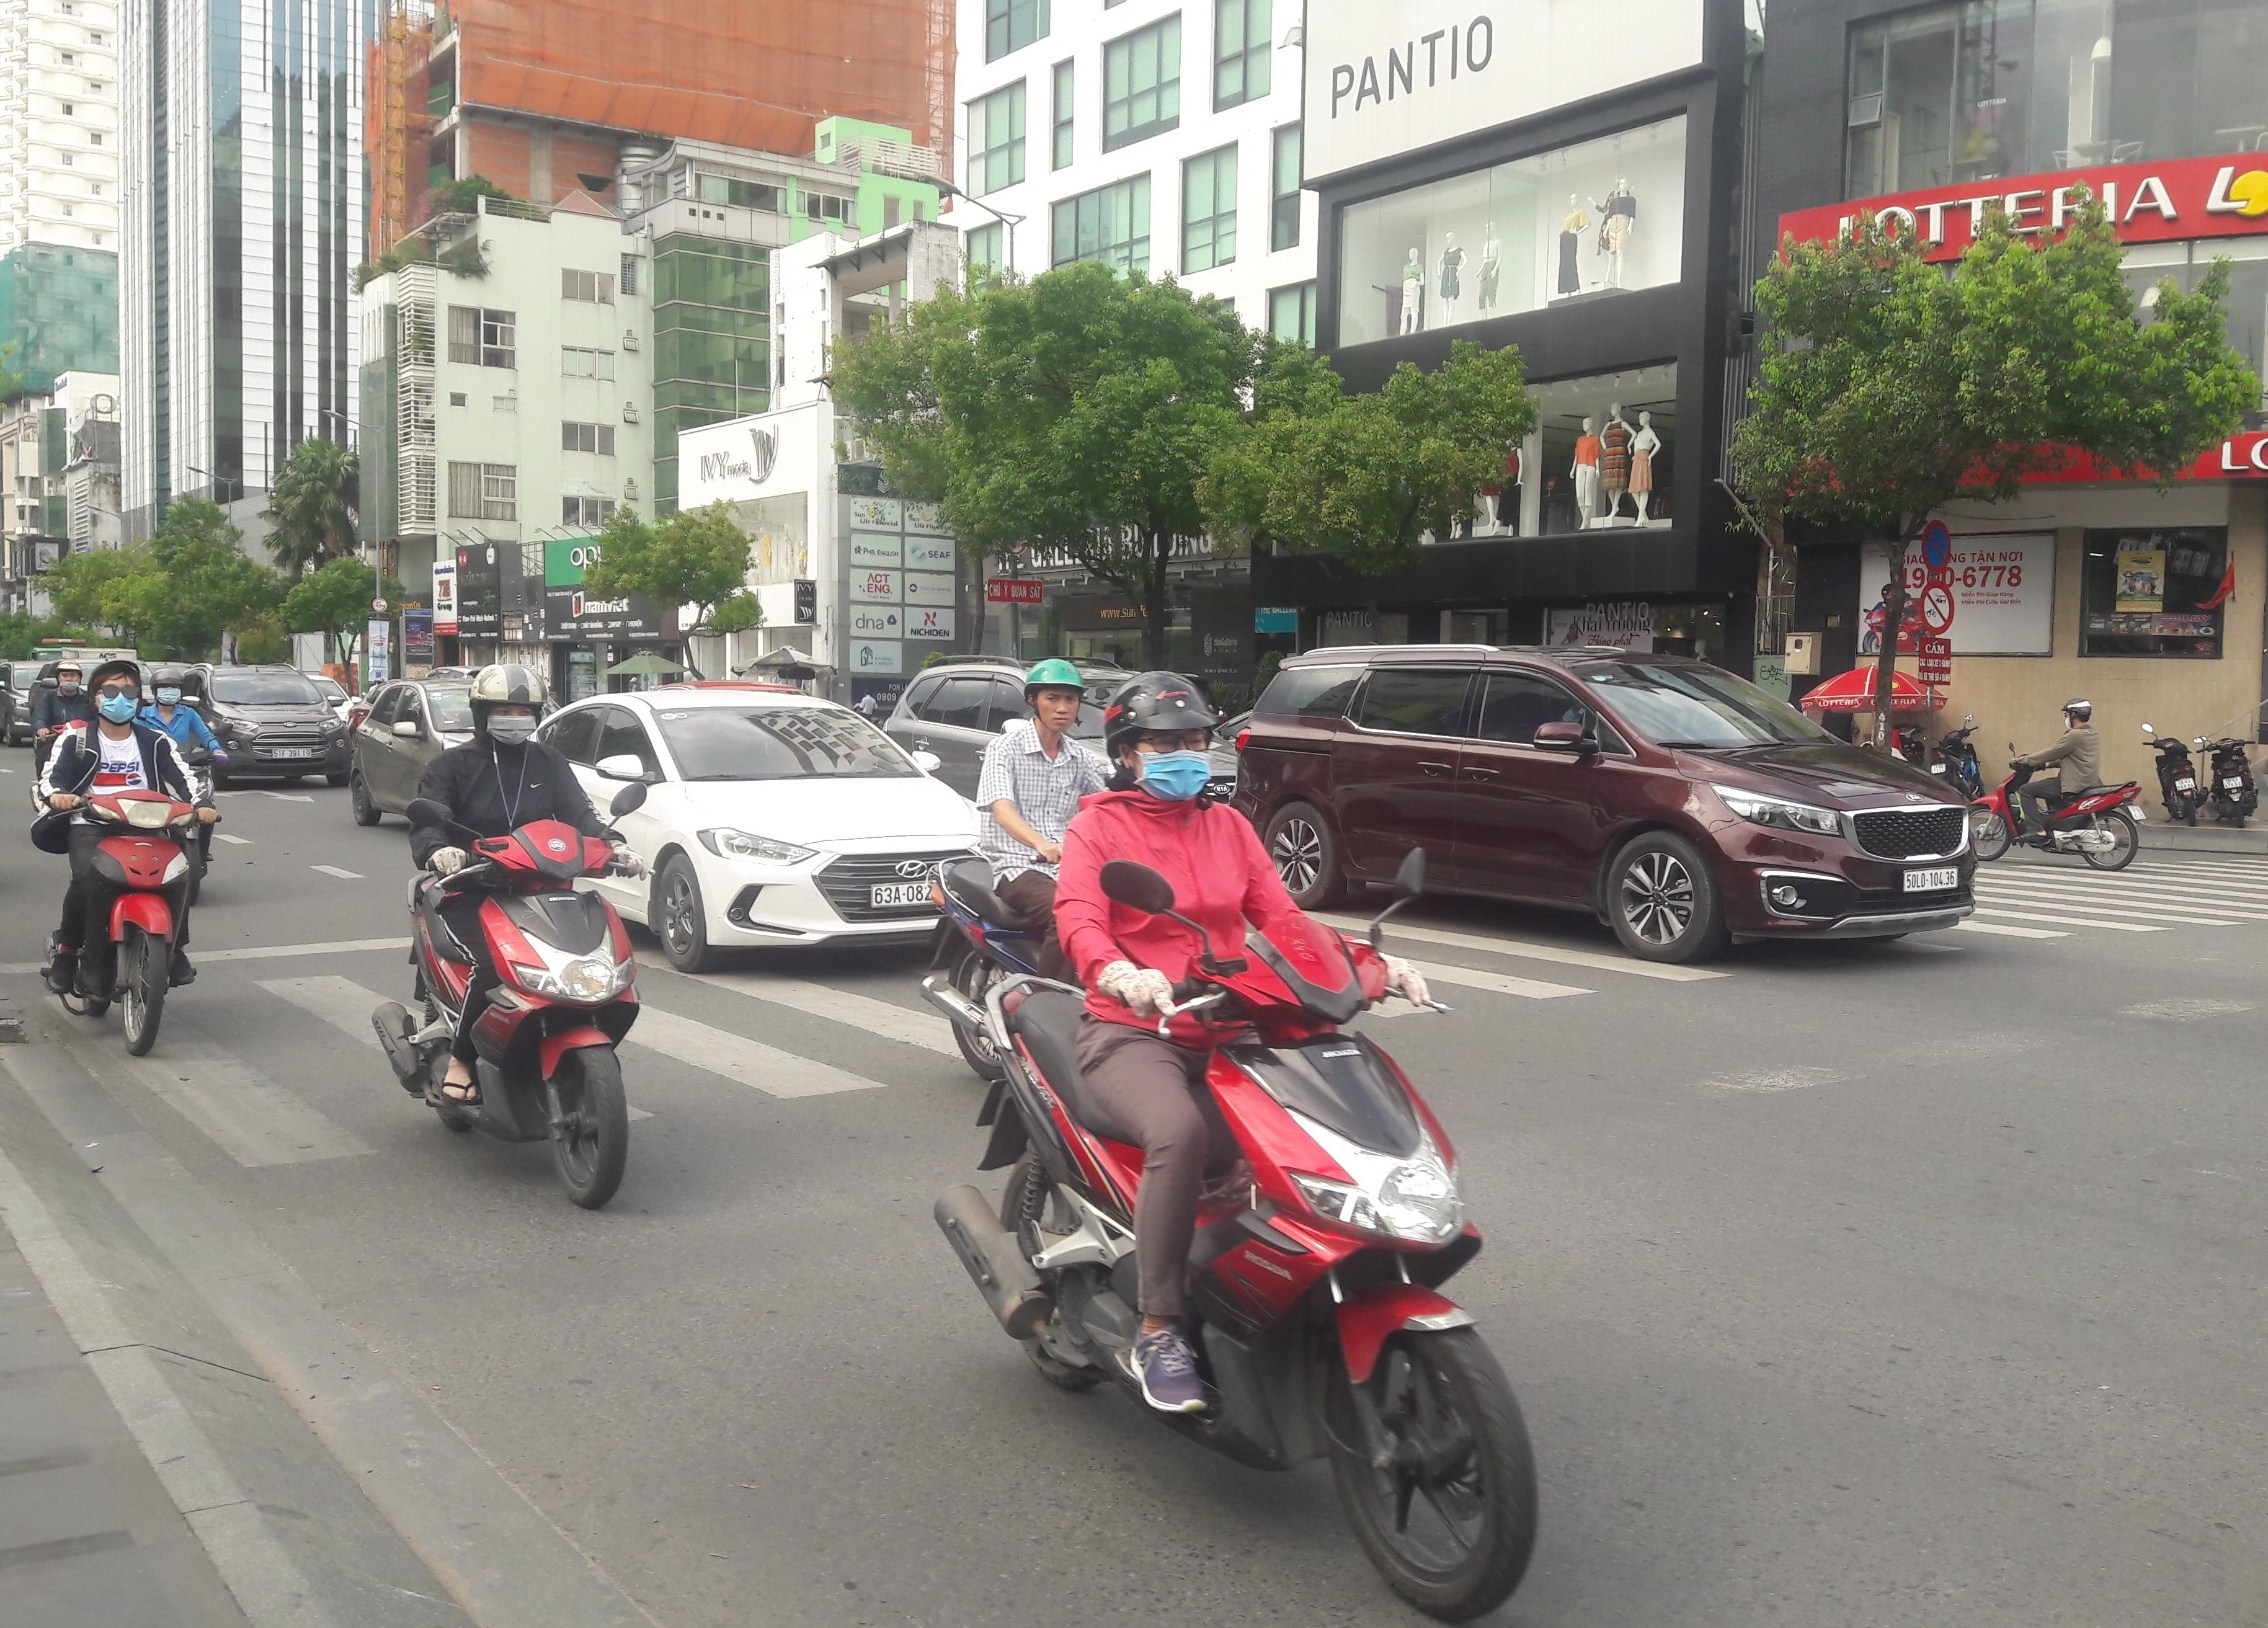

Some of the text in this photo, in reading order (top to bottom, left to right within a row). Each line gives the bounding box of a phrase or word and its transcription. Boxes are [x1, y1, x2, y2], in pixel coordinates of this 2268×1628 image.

[1332, 15, 1493, 119] PANTIO
[700, 451, 729, 482] IVY
[928, 550, 951, 559] SEAF
[1970, 550, 1995, 565] TẬN
[1998, 551, 2023, 562] NƠI
[797, 583, 814, 592] IVY
[989, 583, 1041, 599] CHÚ Ý QUAN SÁT
[1586, 602, 1650, 620] PANTIO
[856, 613, 884, 630] dna
[911, 628, 950, 637] NICHIDEN
[1925, 640, 1945, 654] CẤM
[877, 692, 897, 701] 0909
[1818, 699, 1860, 707] LOTTERIA
[100, 761, 139, 773] PEPSI
[874, 885, 932, 904] 63A-082
